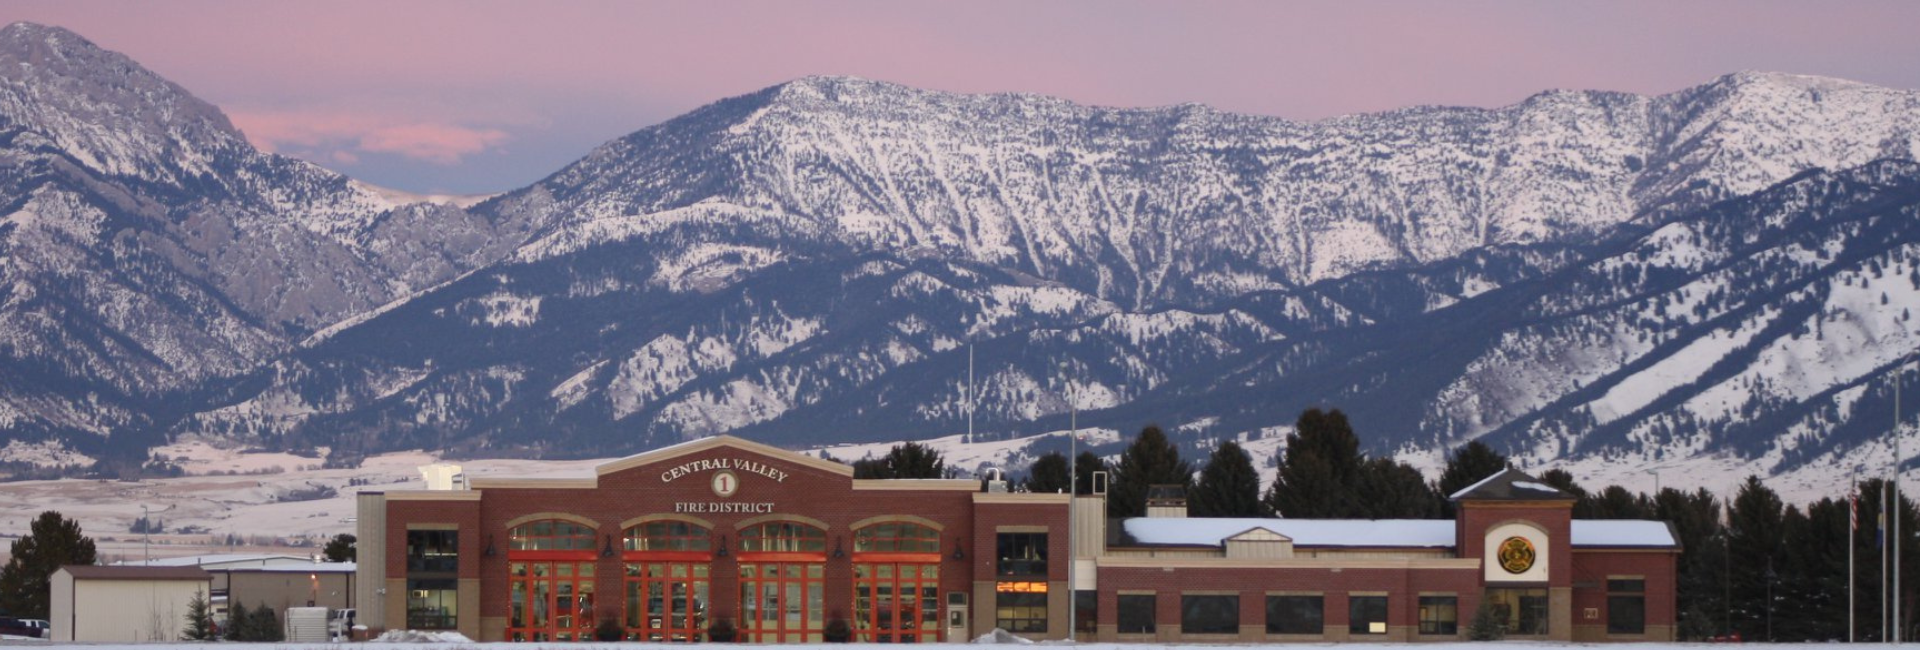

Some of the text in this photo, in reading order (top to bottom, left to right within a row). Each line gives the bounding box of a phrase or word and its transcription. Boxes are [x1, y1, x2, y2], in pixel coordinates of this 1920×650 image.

[661, 458, 788, 483] CENTRAL VALLEY
[719, 476, 730, 492] 1
[675, 502, 775, 513] FIRE DISTRICT
